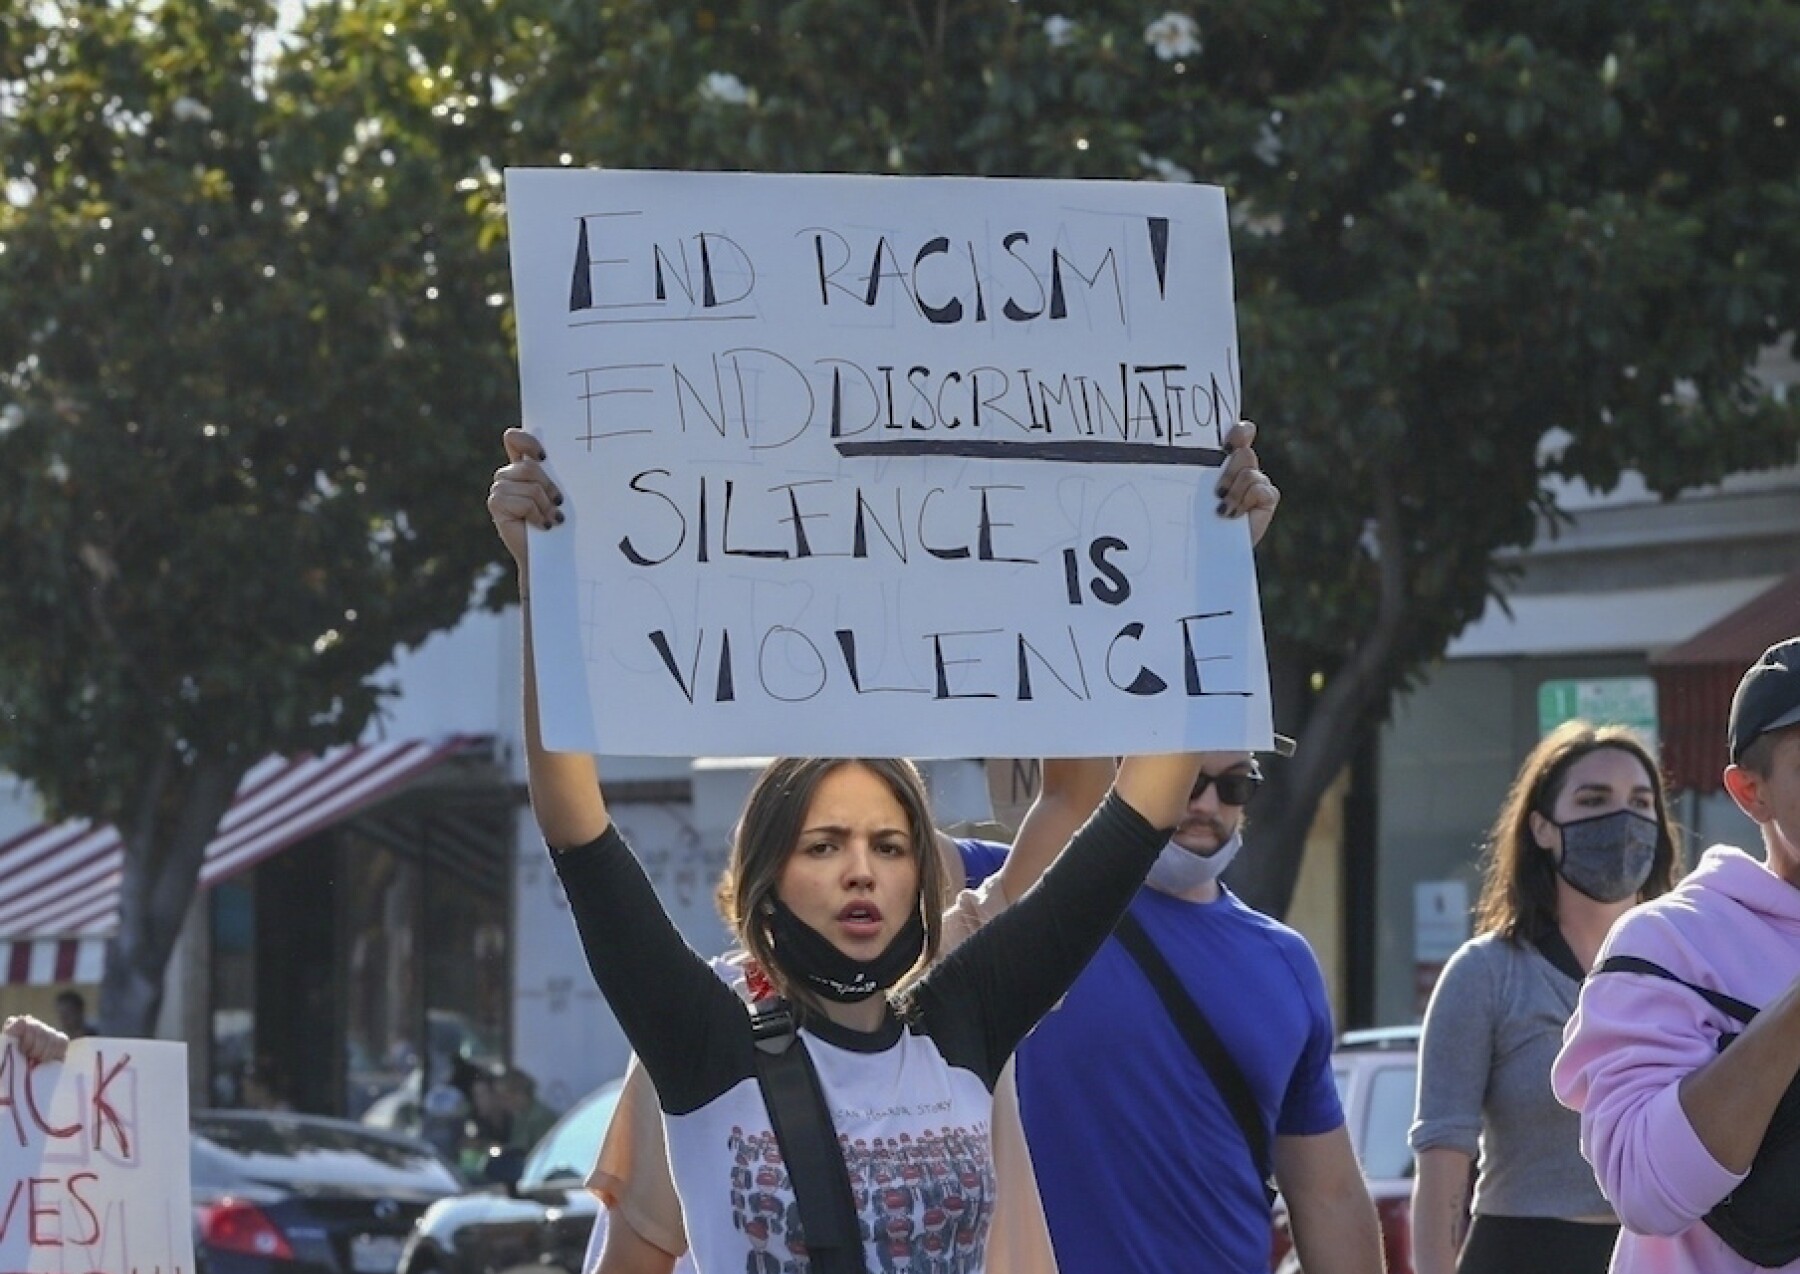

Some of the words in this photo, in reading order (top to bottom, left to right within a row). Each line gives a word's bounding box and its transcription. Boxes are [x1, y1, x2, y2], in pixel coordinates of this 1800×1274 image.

[569, 211, 755, 313] END
[568, 348, 815, 451] END
[815, 346, 1239, 447] DISCRIMINATION
[619, 468, 1039, 566] SILENCE
[1063, 535, 1132, 605] IS
[649, 610, 1254, 703] VIOLENCE
